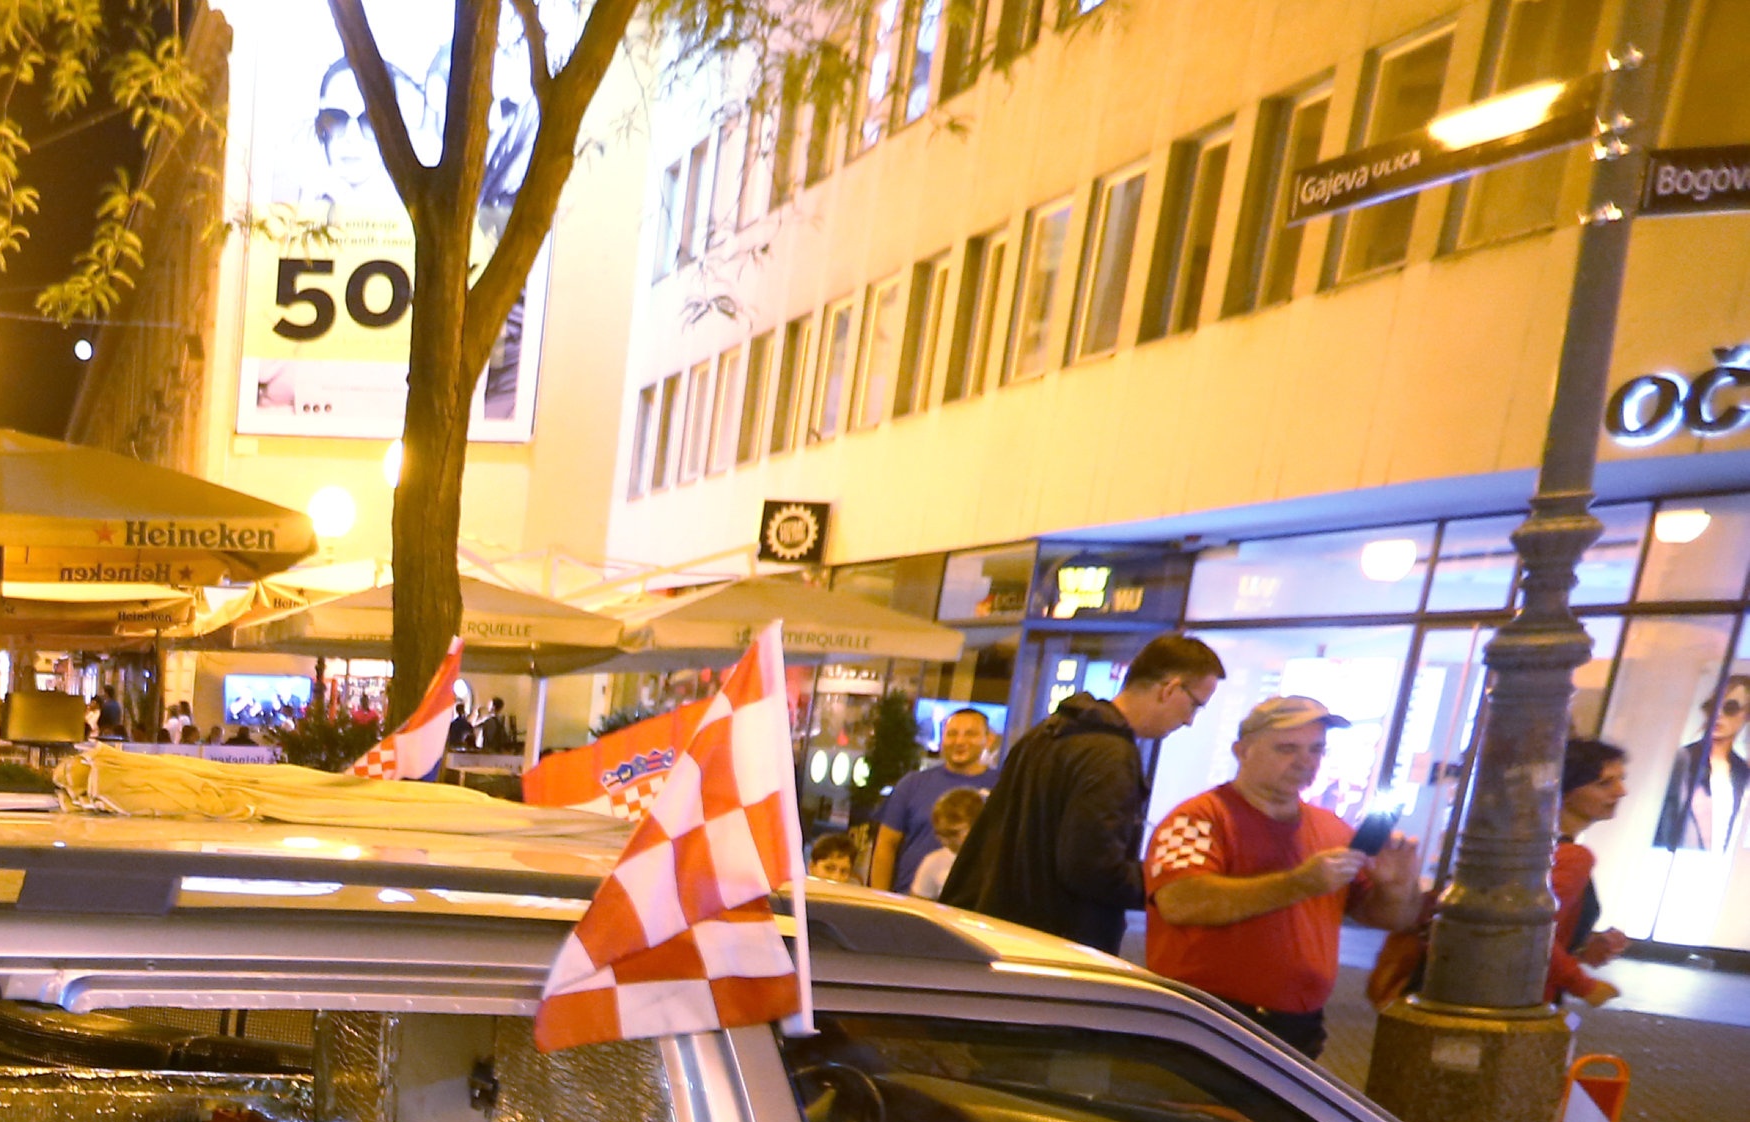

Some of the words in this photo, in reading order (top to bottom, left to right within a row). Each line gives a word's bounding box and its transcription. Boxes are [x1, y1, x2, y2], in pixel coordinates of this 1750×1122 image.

[1301, 165, 1368, 205] Gajeva
[1371, 150, 1421, 181] ULICA
[124, 519, 275, 550] Heineken
[117, 610, 173, 624] Heineken
